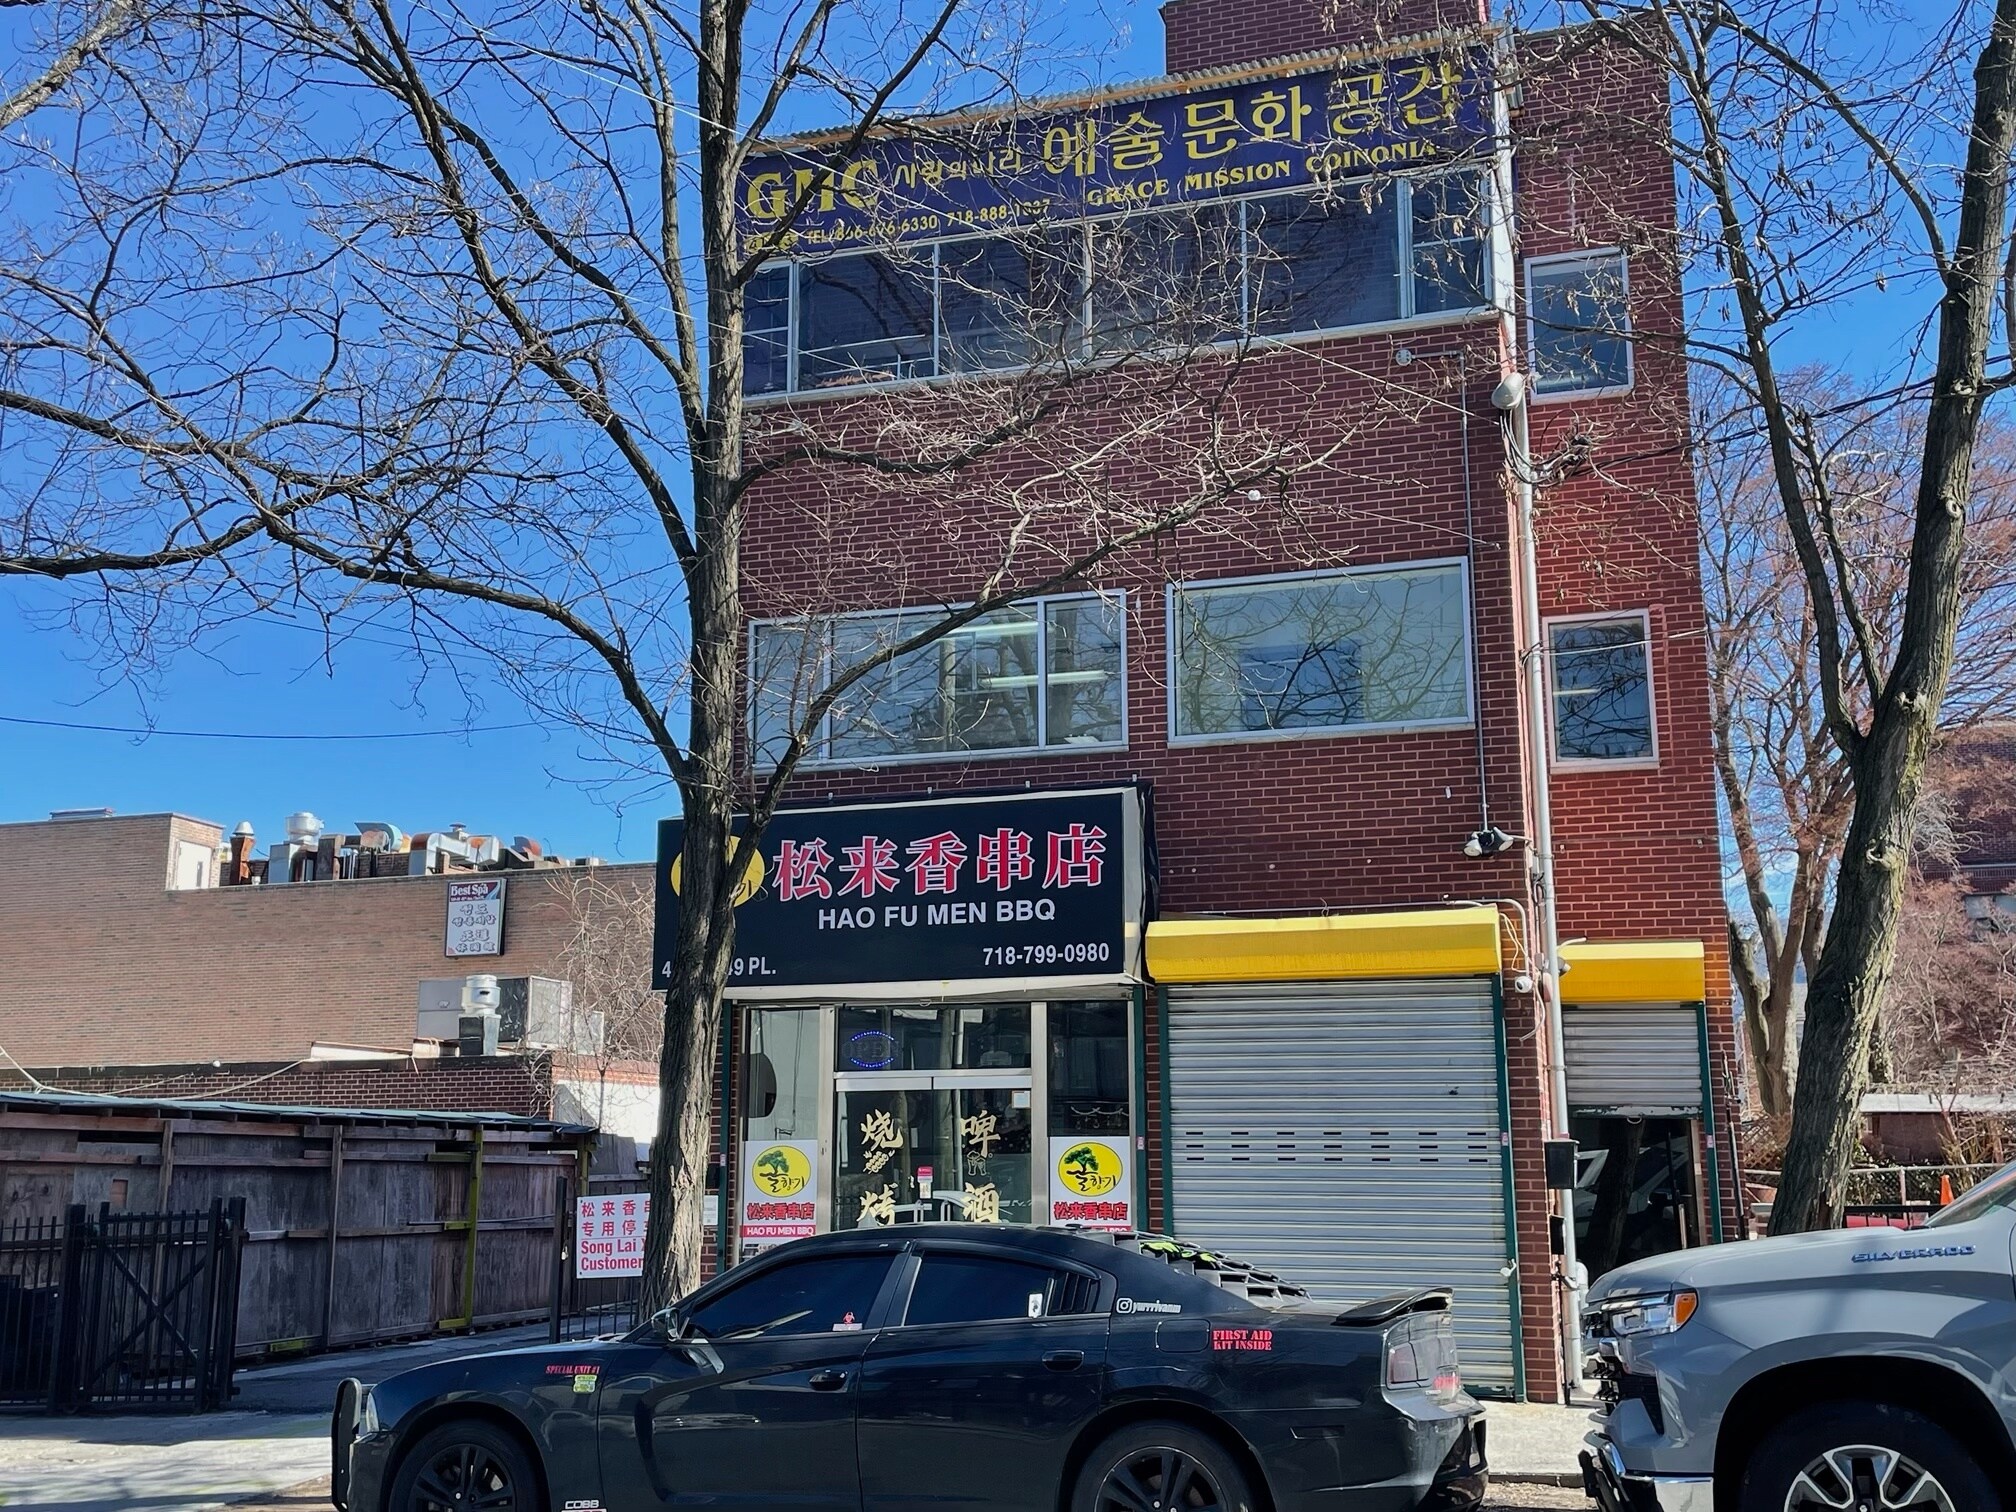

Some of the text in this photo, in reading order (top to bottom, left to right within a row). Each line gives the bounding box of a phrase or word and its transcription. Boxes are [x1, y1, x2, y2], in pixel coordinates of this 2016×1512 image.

[1087, 140, 1437, 206] GRACE MISSION COINONIA
[747, 159, 879, 218] GMC
[772, 822, 1108, 902] 松来香串店
[450, 883, 488, 896] Best Spa
[818, 898, 1056, 930] HAO FU MEN BBQ
[983, 942, 1110, 968] 718-799-0980
[748, 956, 777, 975] PL.
[747, 1202, 815, 1220] 松来香串店
[1053, 1201, 1128, 1220] 松来香串店
[747, 1226, 765, 1235] HAO
[766, 1226, 776, 1235] FU
[777, 1226, 796, 1235] MEN
[581, 1240, 612, 1256] Song
[617, 1238, 636, 1252] Lai
[1851, 1245, 1976, 1263] SILVERADO
[1213, 1329, 1273, 1341] FIRST AID
[1214, 1340, 1272, 1350] KIT INSIDE
[545, 1365, 574, 1374] SPECIAL
[574, 1365, 591, 1374] UNIT
[565, 1499, 600, 1510] COBB
